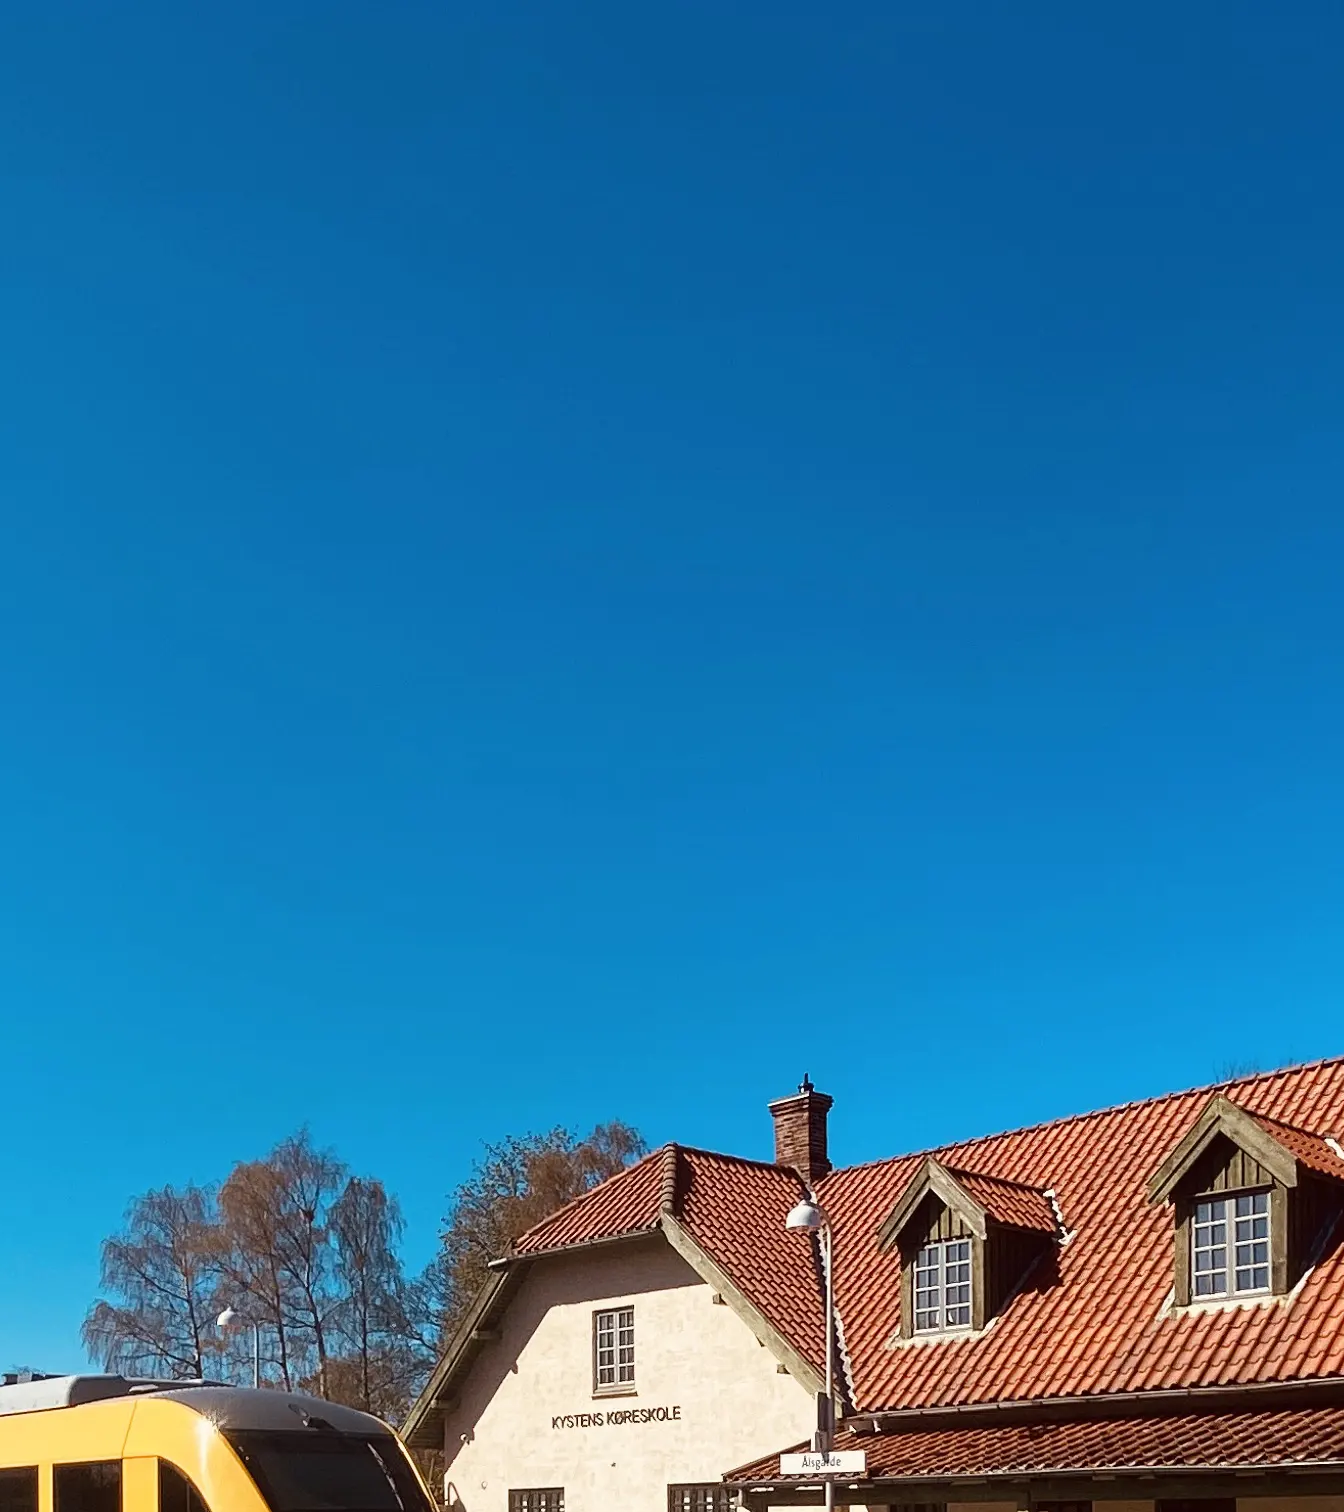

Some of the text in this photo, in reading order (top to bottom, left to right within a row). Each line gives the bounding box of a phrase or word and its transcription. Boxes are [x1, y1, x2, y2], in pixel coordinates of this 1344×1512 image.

[552, 1406, 681, 1429] KYSTENS KØRESKOLE
[801, 1455, 842, 1470] Ålsgåde
